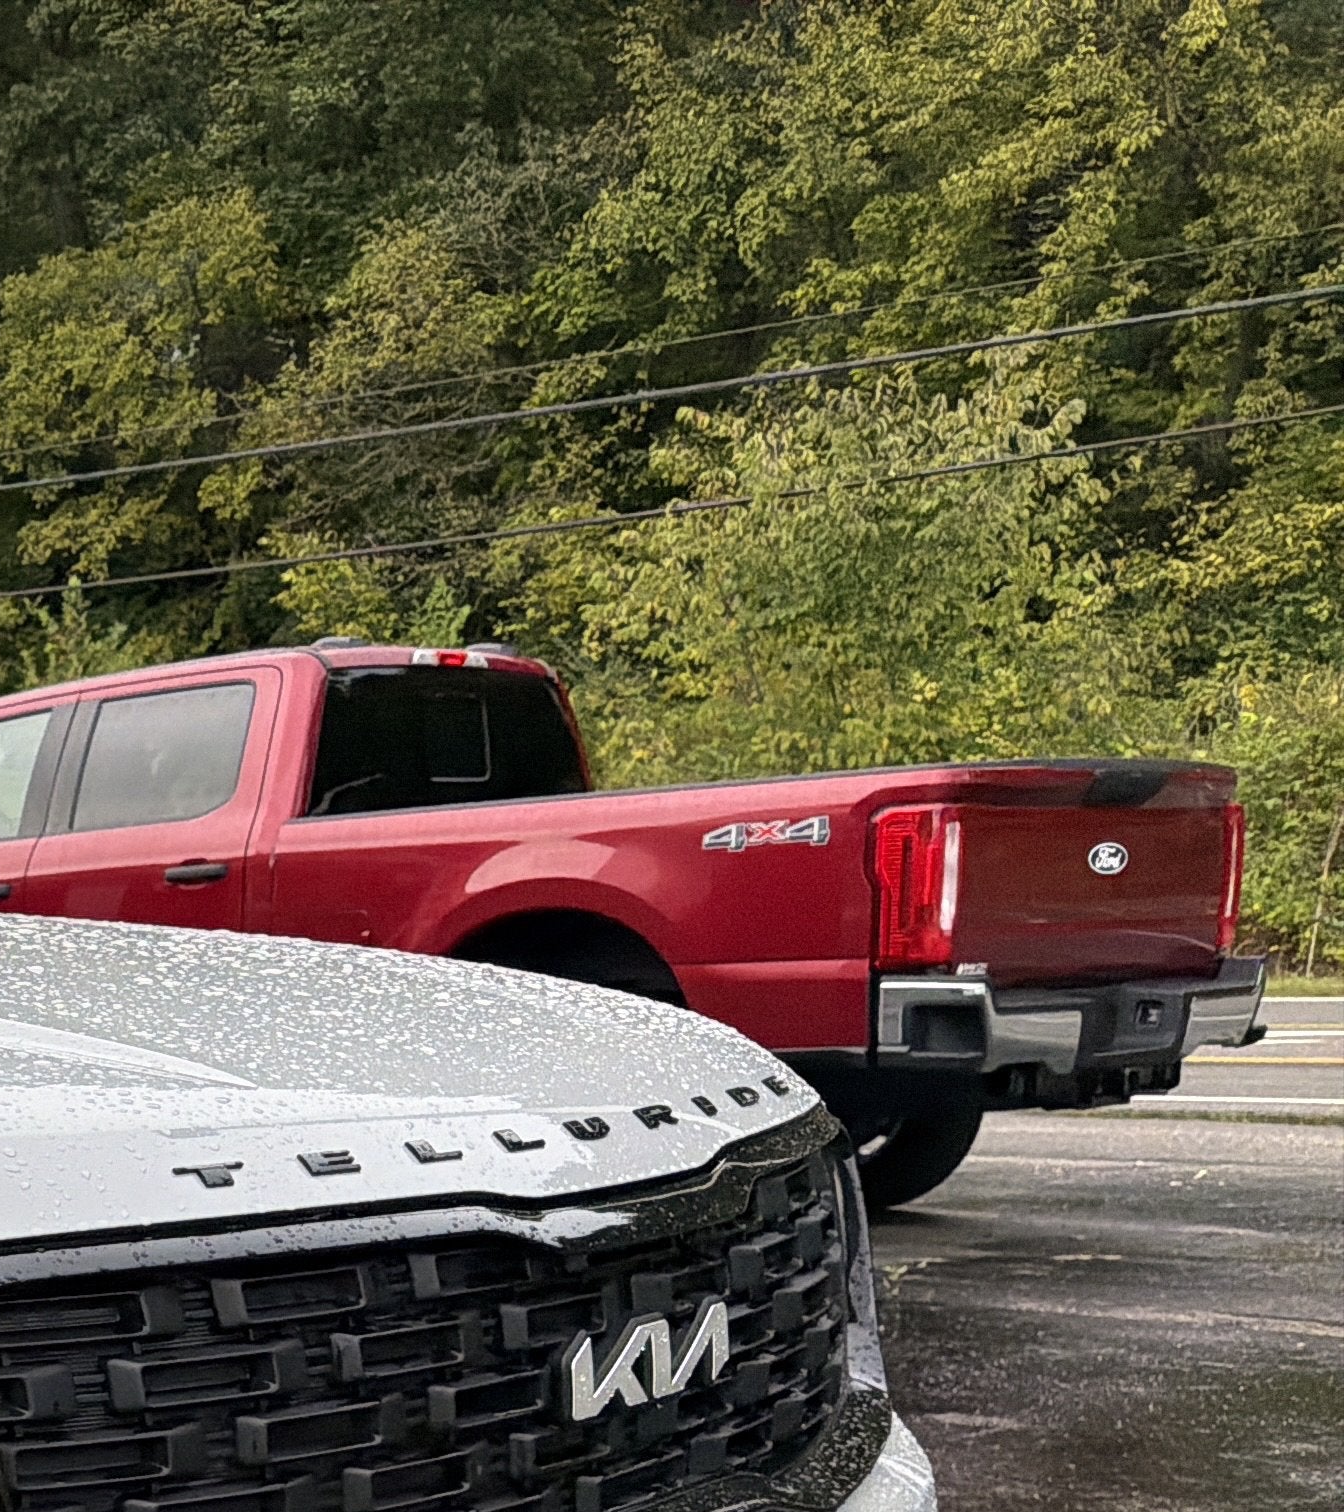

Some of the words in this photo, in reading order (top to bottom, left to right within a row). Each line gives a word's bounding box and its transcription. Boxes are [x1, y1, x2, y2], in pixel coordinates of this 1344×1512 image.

[1095, 846, 1123, 869] Ford
[172, 1074, 791, 1188] TELLURIDE
[568, 1300, 730, 1421] KIA
